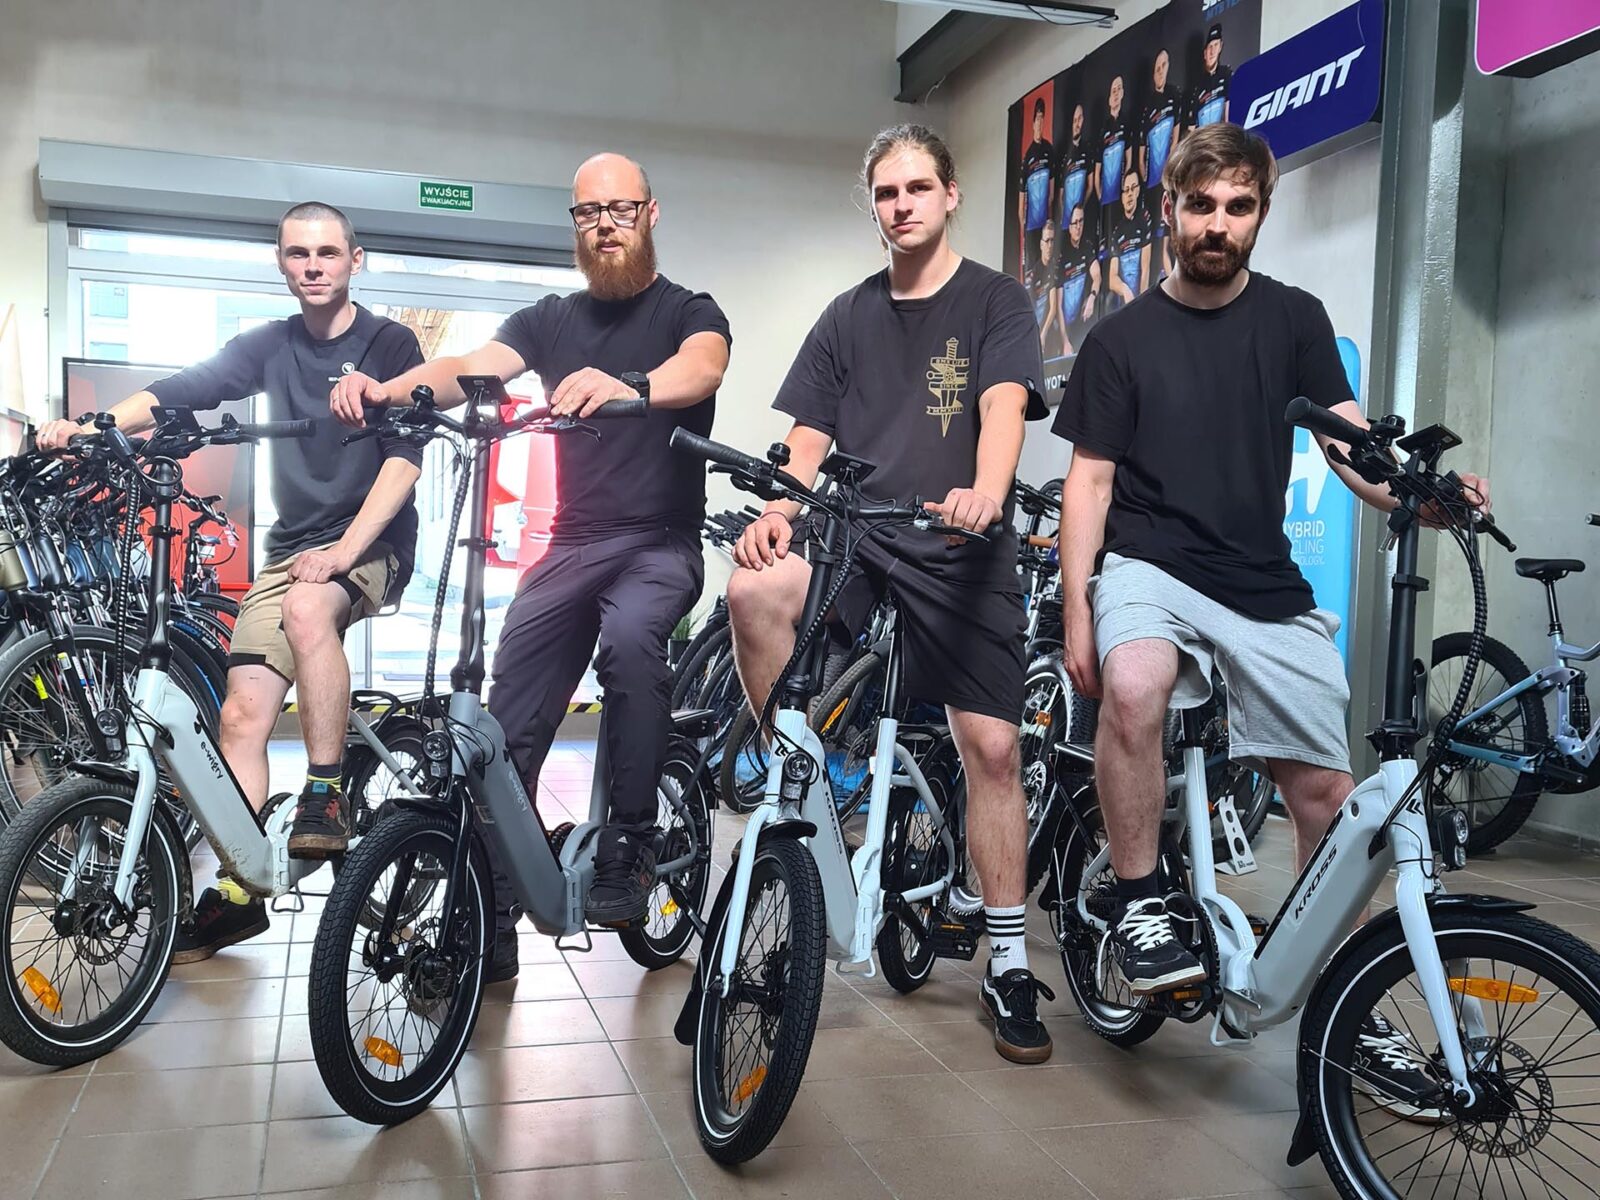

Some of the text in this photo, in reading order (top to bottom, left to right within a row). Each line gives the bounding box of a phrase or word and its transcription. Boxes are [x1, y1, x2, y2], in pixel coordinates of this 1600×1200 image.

[1243, 45, 1366, 131] GIANT
[424, 186, 469, 199] WYJŚCIE
[421, 196, 472, 207] EWAKUACYJNE
[1292, 539, 1325, 554] CLING
[1294, 843, 1337, 920] KROSS
